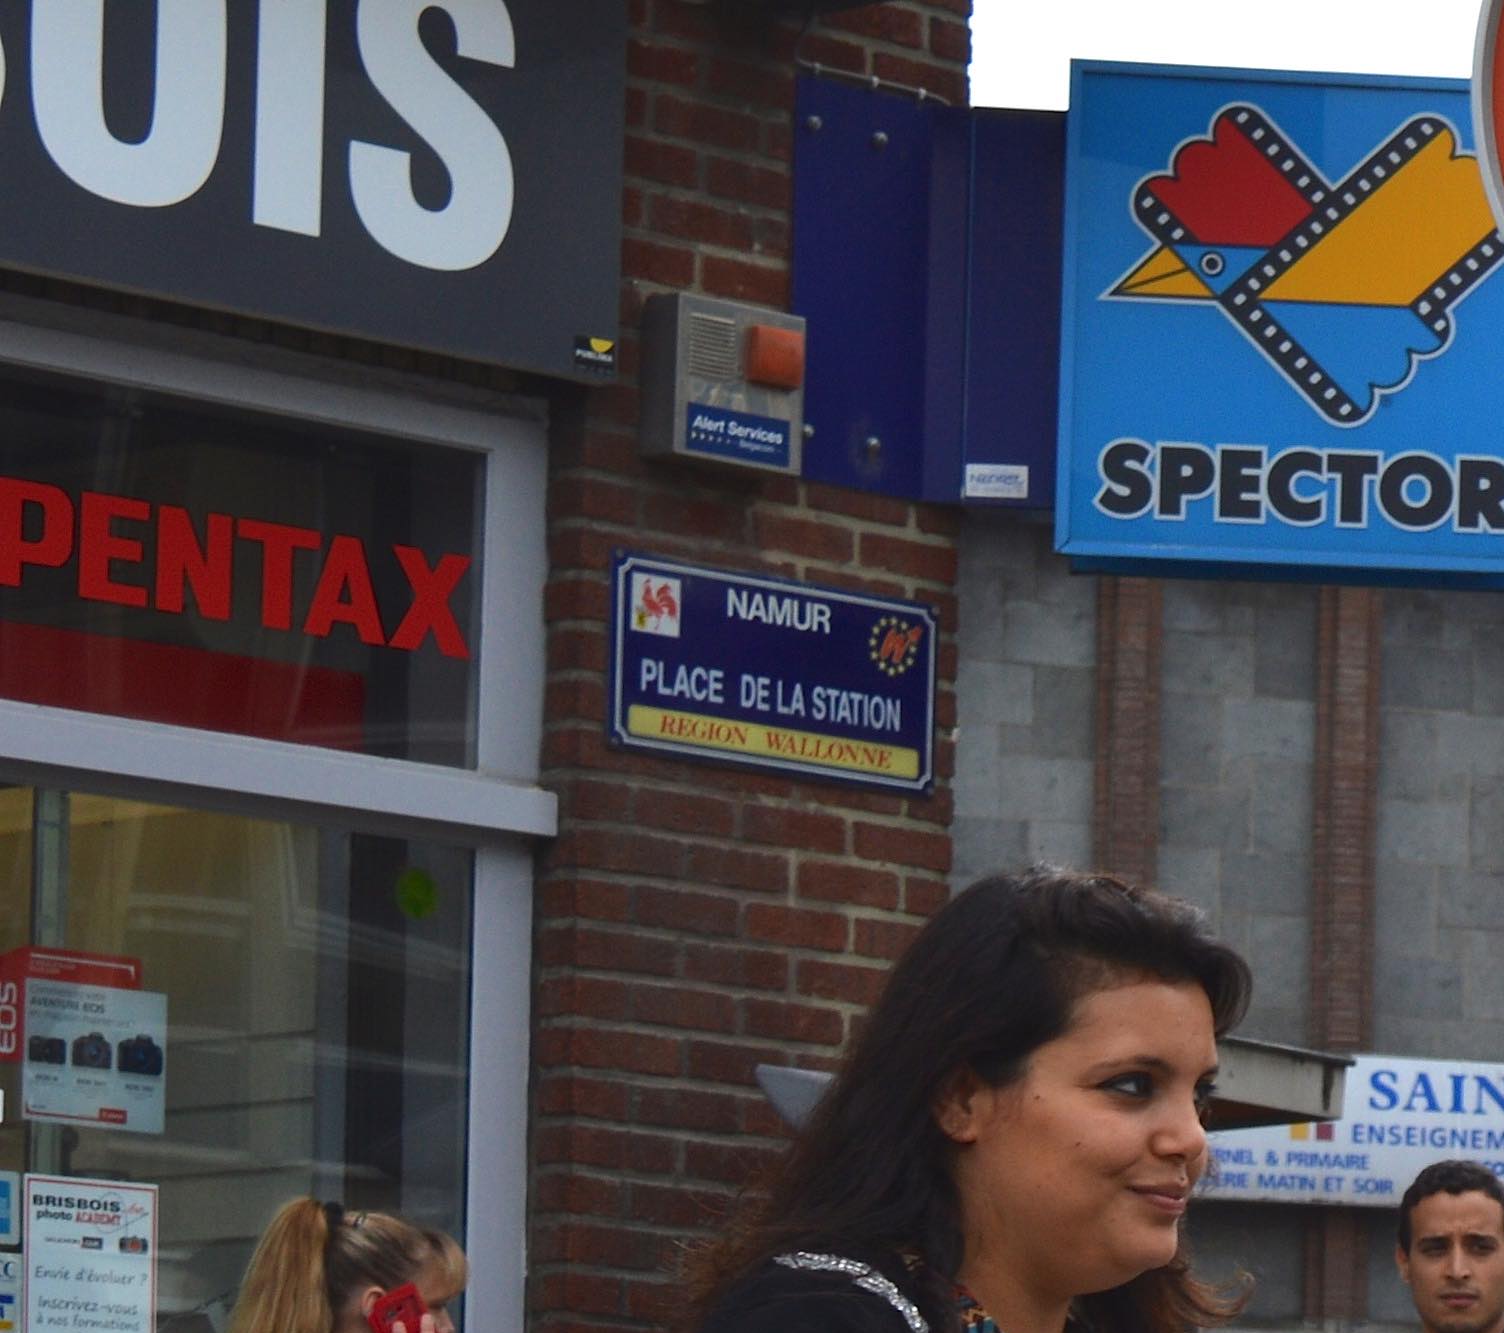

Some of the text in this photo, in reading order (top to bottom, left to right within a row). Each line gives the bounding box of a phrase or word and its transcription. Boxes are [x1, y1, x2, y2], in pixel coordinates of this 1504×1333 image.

[692, 415, 783, 444] Alert Services
[0, 476, 471, 660] PENTAX
[727, 588, 831, 634] NAMUR
[641, 658, 901, 732] PLACE DE LA STATION
[660, 714, 892, 769] REGION WALLONNE
[1265, 1151, 1279, 1167] &
[1286, 1151, 1370, 1171] PRIMAIRE
[1257, 1172, 1316, 1191] MATIN
[1323, 1174, 1344, 1193] ET
[1353, 1177, 1393, 1195] SOIR
[33, 1193, 121, 1213] BRISBOIS
[36, 1208, 73, 1222] photo
[35, 1265, 71, 1281] Envie
[141, 1272, 148, 1286] ?
[38, 1296, 140, 1316] Inscrivez-vous
[36, 1315, 141, 1332] à nos formations
